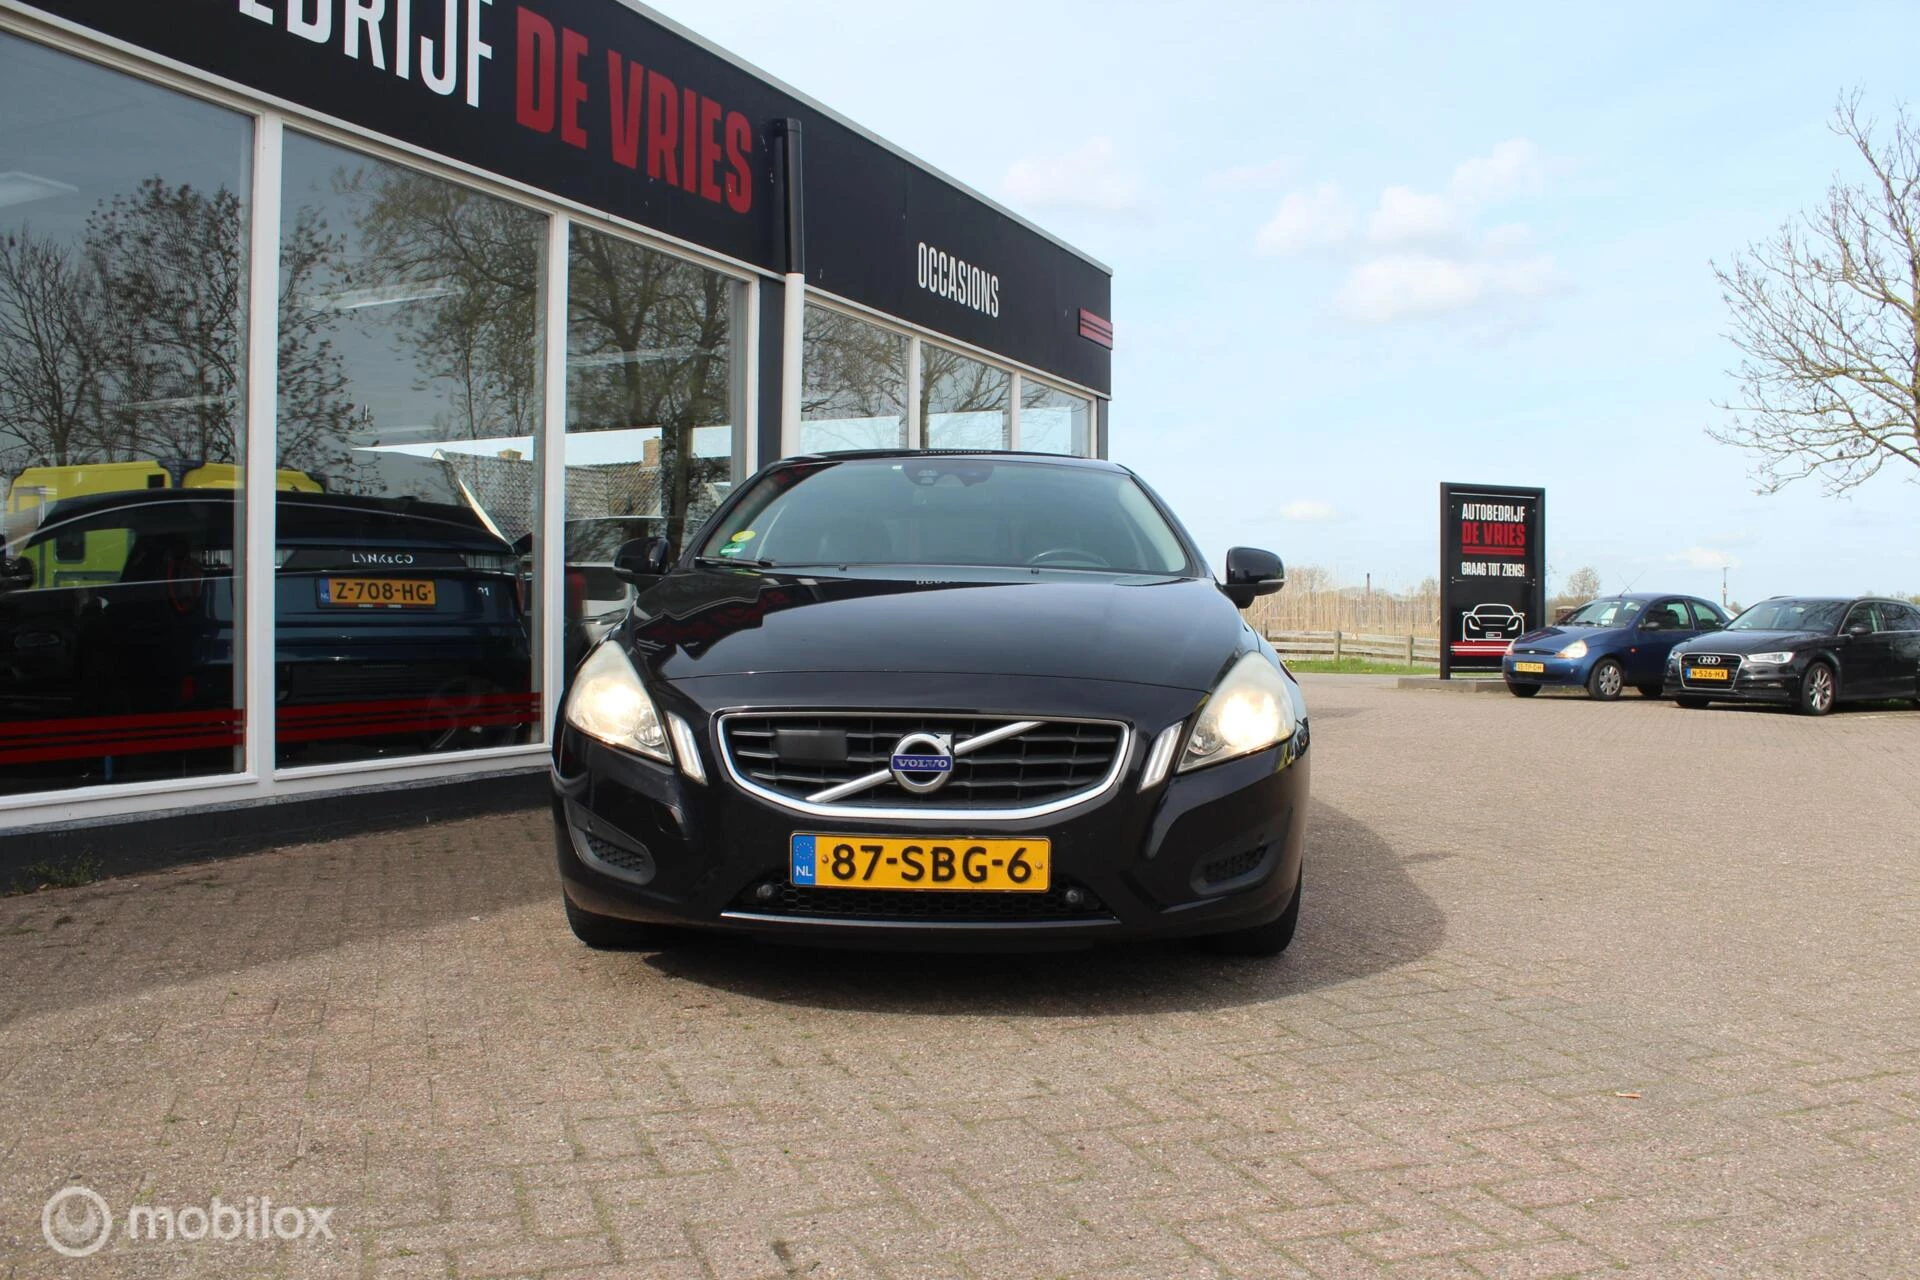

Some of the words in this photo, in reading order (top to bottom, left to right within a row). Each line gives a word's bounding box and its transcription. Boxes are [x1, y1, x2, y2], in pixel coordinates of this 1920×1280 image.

[516, 6, 589, 150] DE
[607, 49, 752, 214] VRIES
[917, 241, 1000, 318] OCCASIONS
[1462, 503, 1525, 522] AUTOBEDRIJF
[1462, 521, 1480, 544] DE
[1483, 522, 1526, 546] VRIES
[1461, 561, 1487, 576] GRAAG
[1487, 562, 1501, 576] TOT
[1502, 563, 1526, 577] ZIENS!
[335, 582, 429, 601] Z-708-HG
[897, 759, 948, 768] VOLVO
[796, 866, 813, 877] NL
[831, 843, 1032, 884] 87-SBG-6
